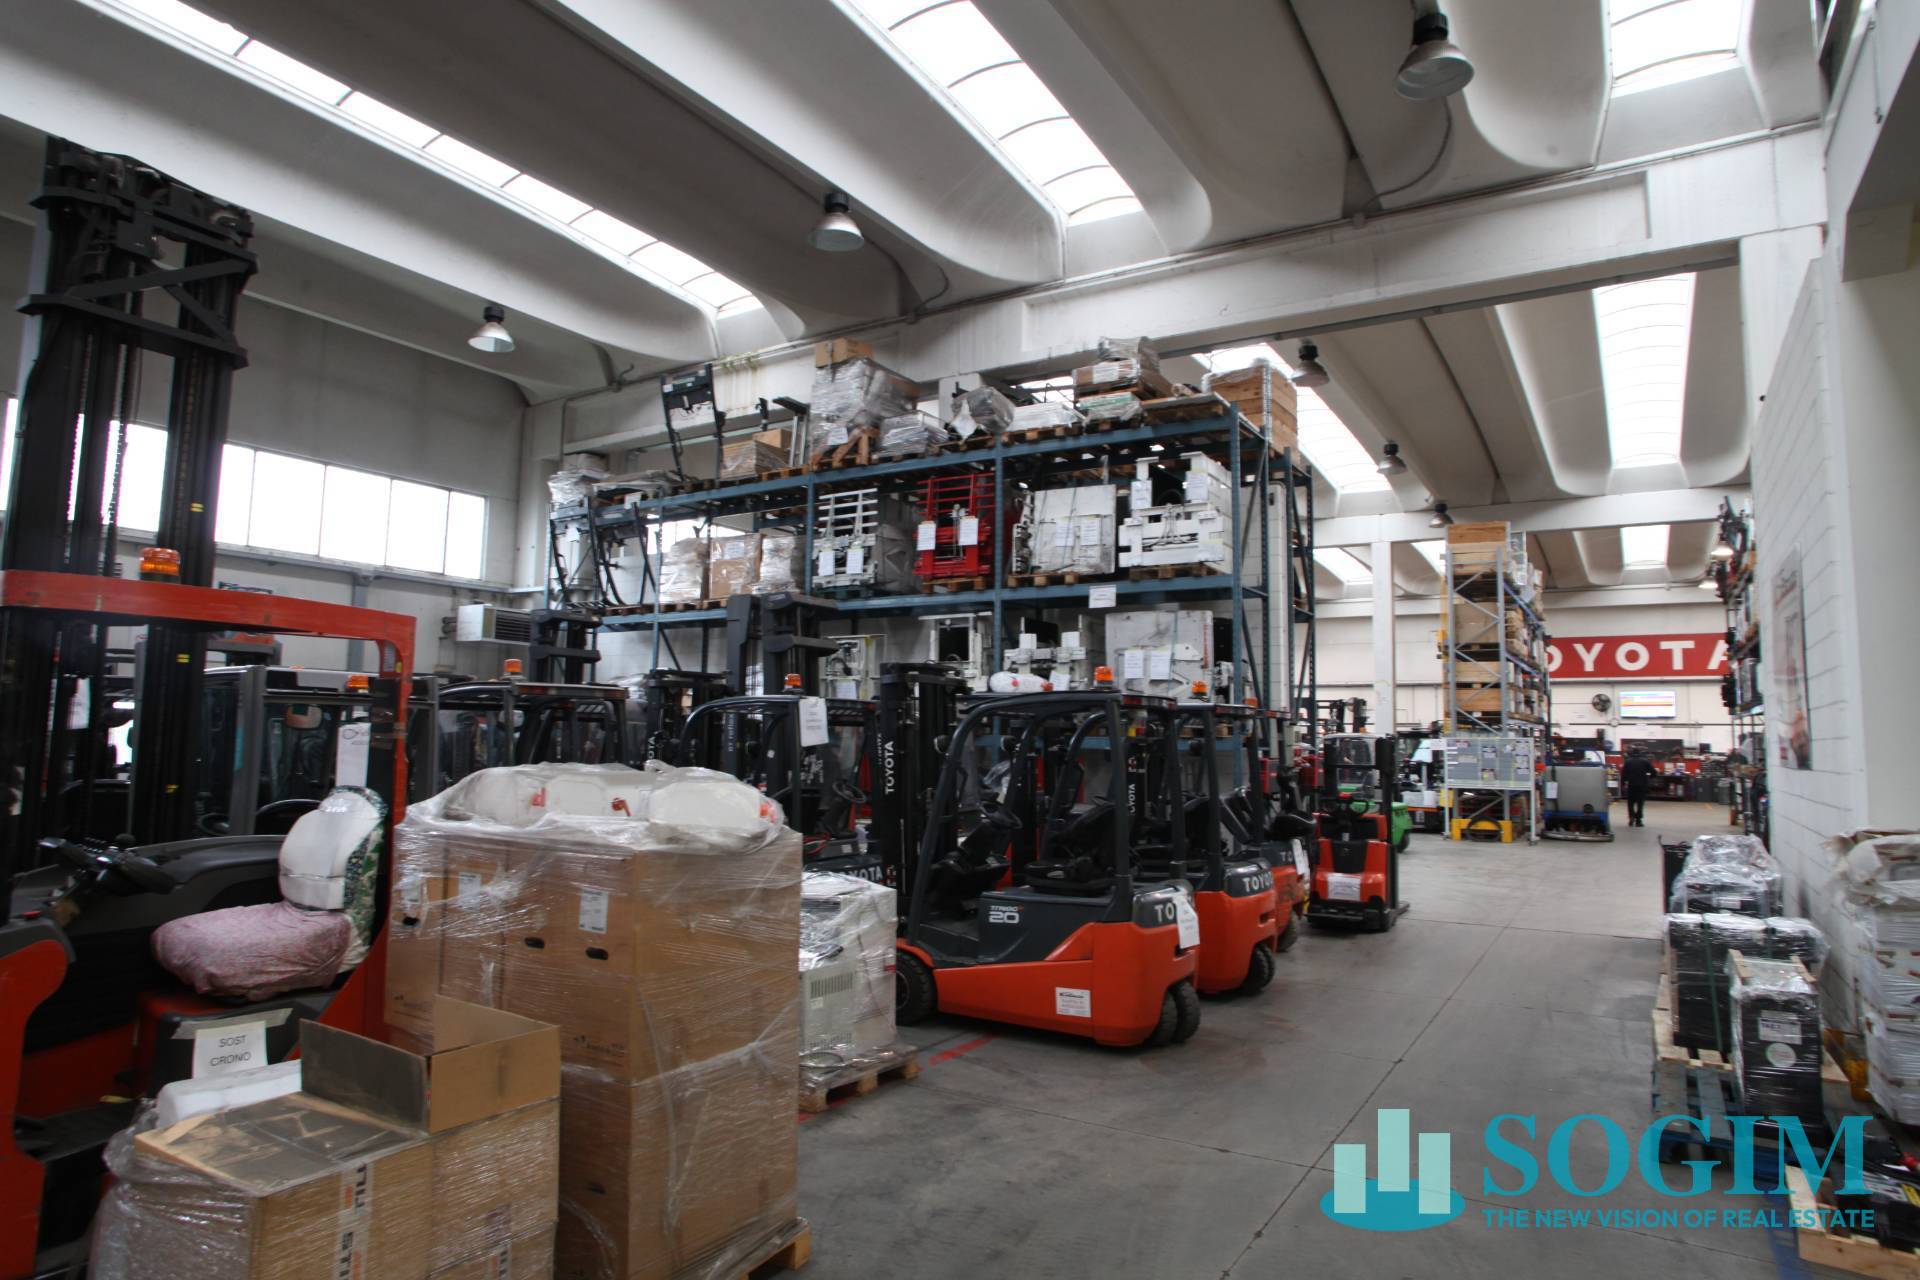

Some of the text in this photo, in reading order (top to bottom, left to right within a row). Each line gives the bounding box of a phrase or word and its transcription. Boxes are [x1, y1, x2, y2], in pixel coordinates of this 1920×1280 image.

[884, 741, 895, 794] TOYOTA
[988, 911, 1020, 923] 20
[218, 1035, 247, 1048] SOST
[209, 1051, 252, 1067] CRONO
